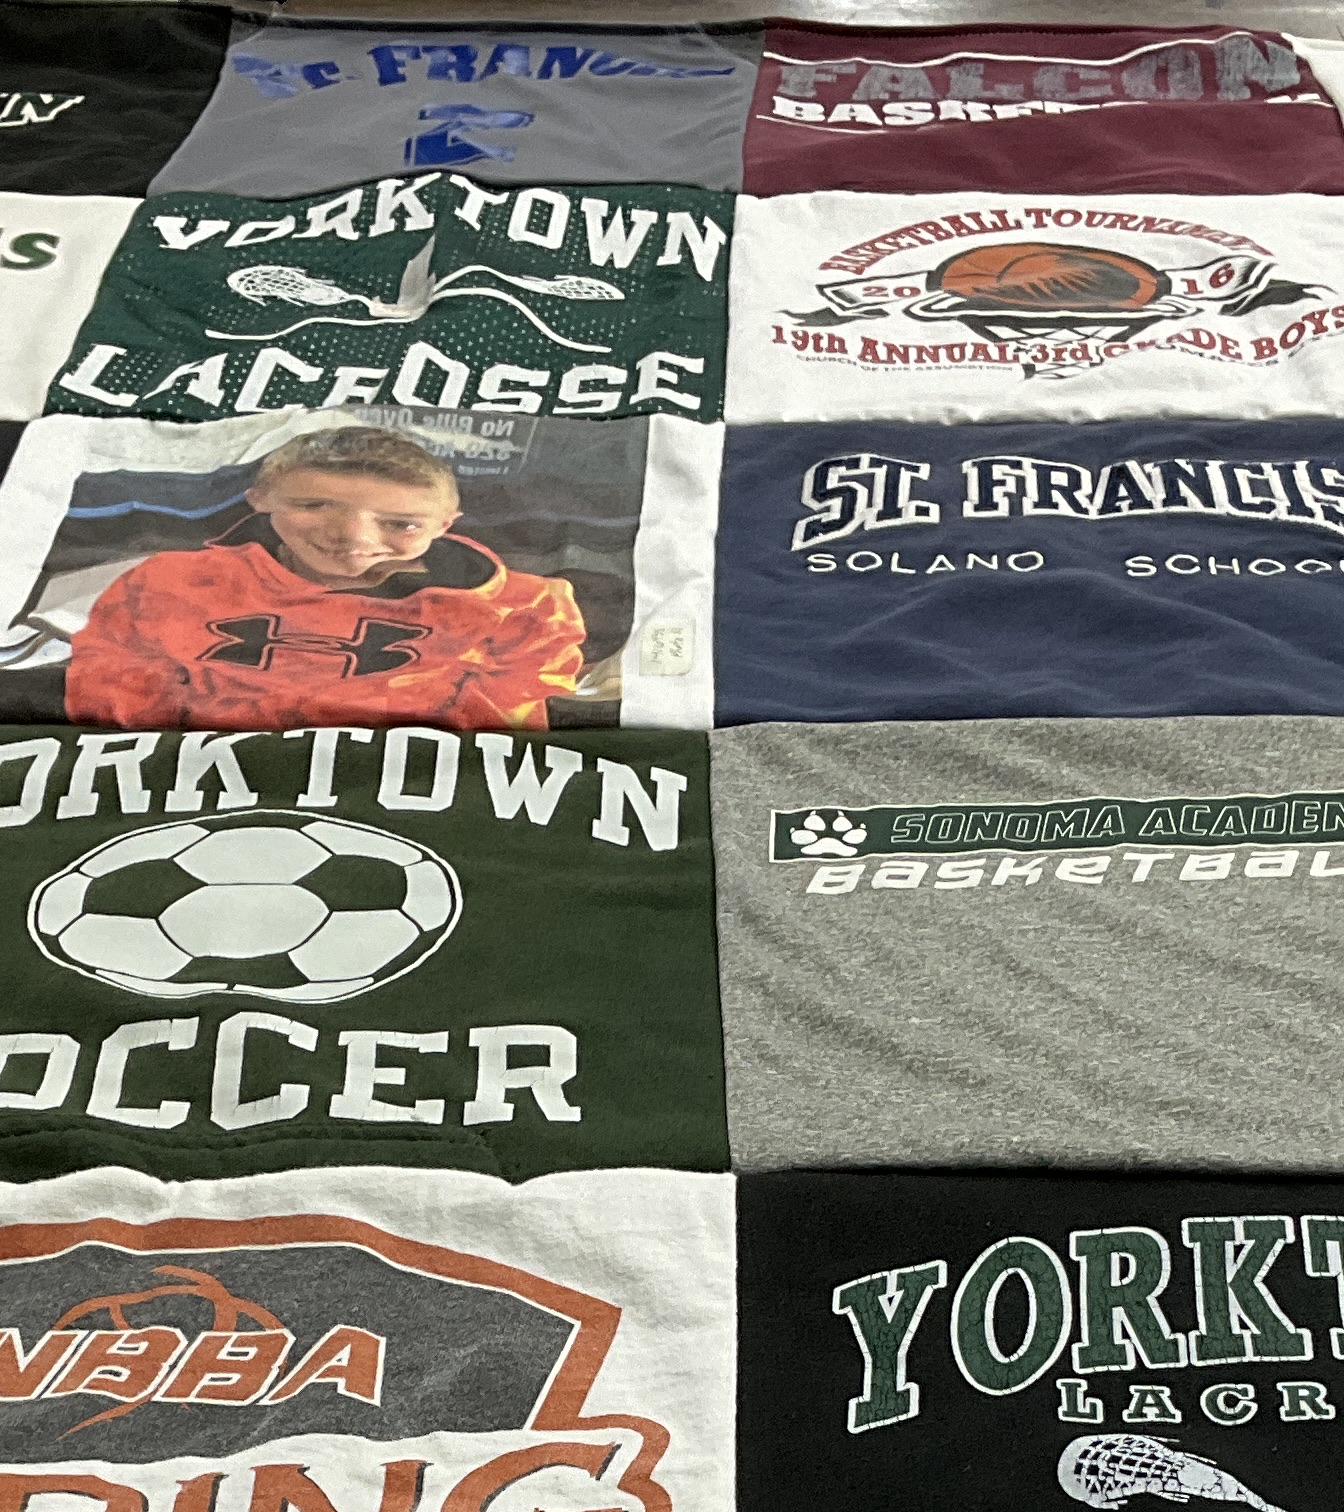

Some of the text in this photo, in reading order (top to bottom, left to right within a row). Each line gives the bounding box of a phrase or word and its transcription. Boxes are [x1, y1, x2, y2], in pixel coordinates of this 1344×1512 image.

[367, 41, 736, 87] FRAN
[149, 172, 727, 282] YORKTOWN
[862, 262, 1236, 298] 20 16
[771, 324, 849, 356] 19th
[858, 335, 1021, 365] ANNUAL
[1030, 341, 1094, 363] 3rd
[58, 340, 705, 416] LACROSSE
[790, 452, 942, 552] ST.
[806, 549, 1046, 576] SOLANO
[887, 802, 1129, 846] SONOMA
